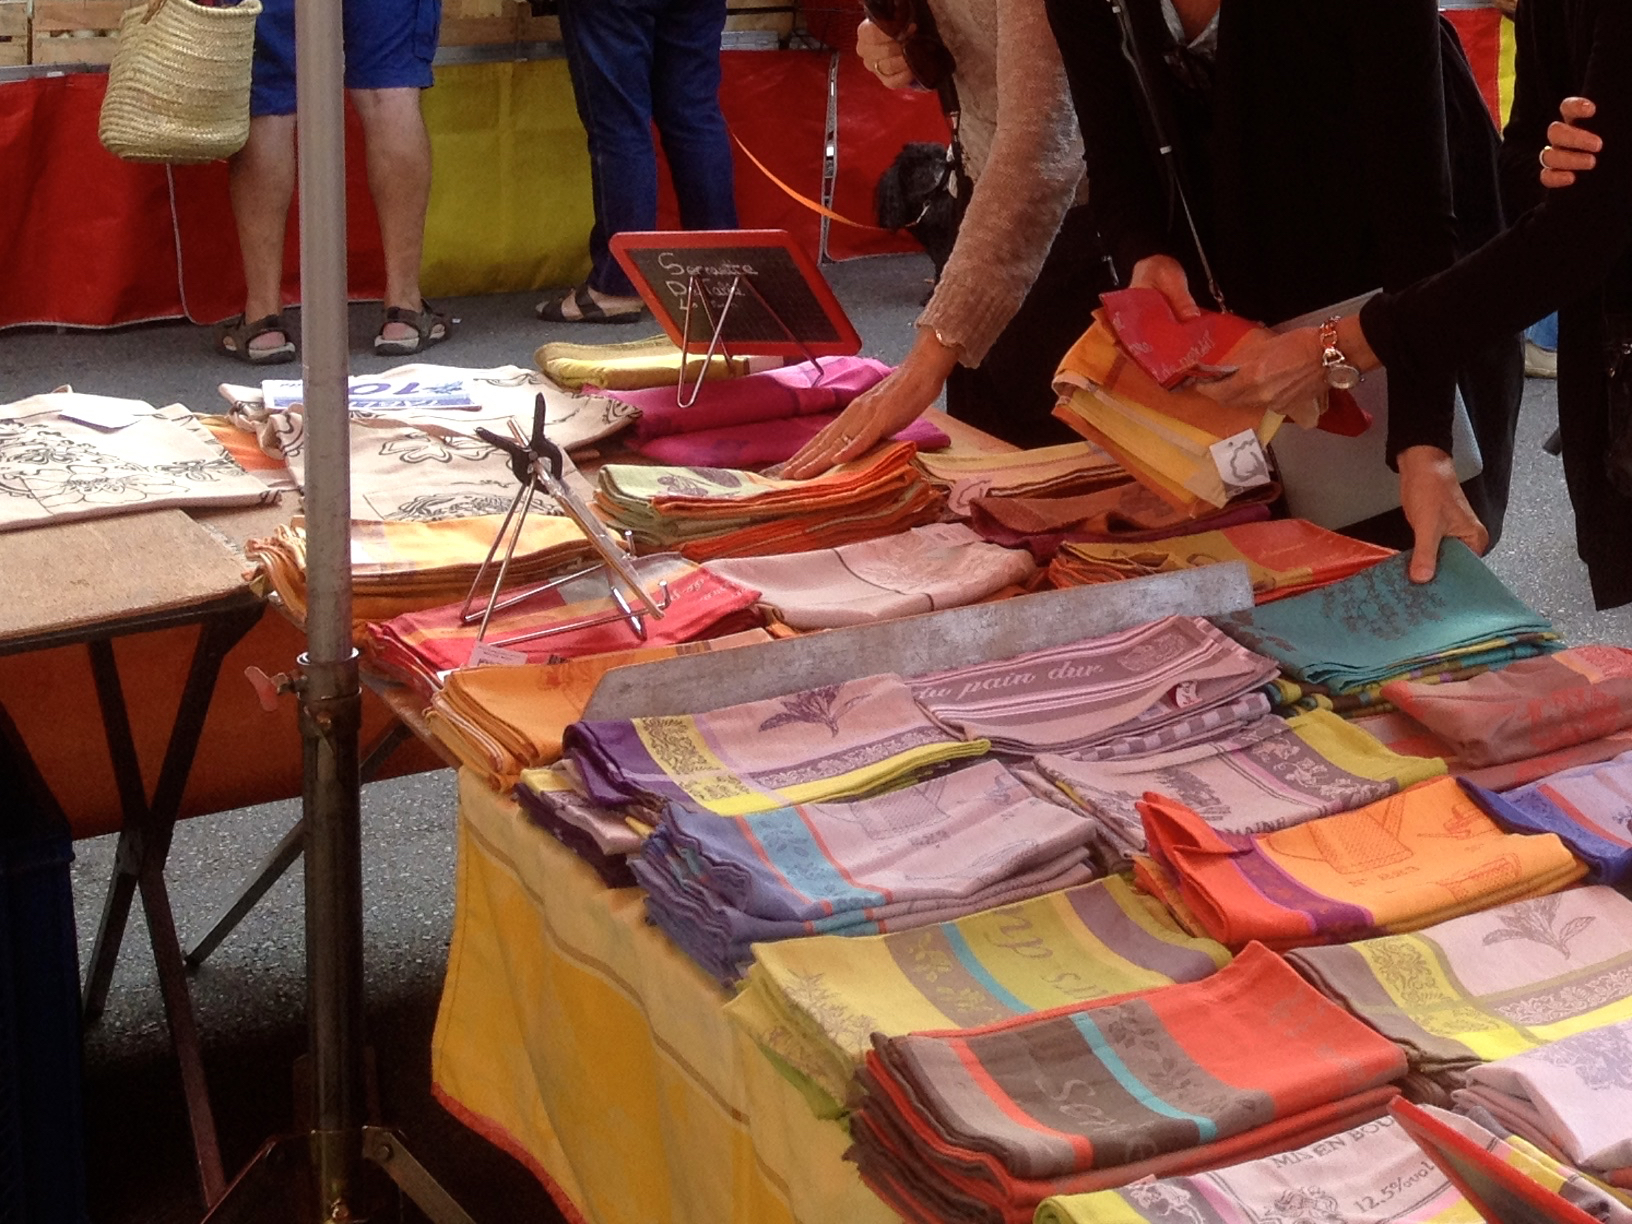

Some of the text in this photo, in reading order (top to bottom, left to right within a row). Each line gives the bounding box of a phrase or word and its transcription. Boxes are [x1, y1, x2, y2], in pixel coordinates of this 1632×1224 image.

[956, 671, 1037, 700] pain
[1047, 660, 1104, 680] dur
[1313, 1136, 1346, 1157] EN
